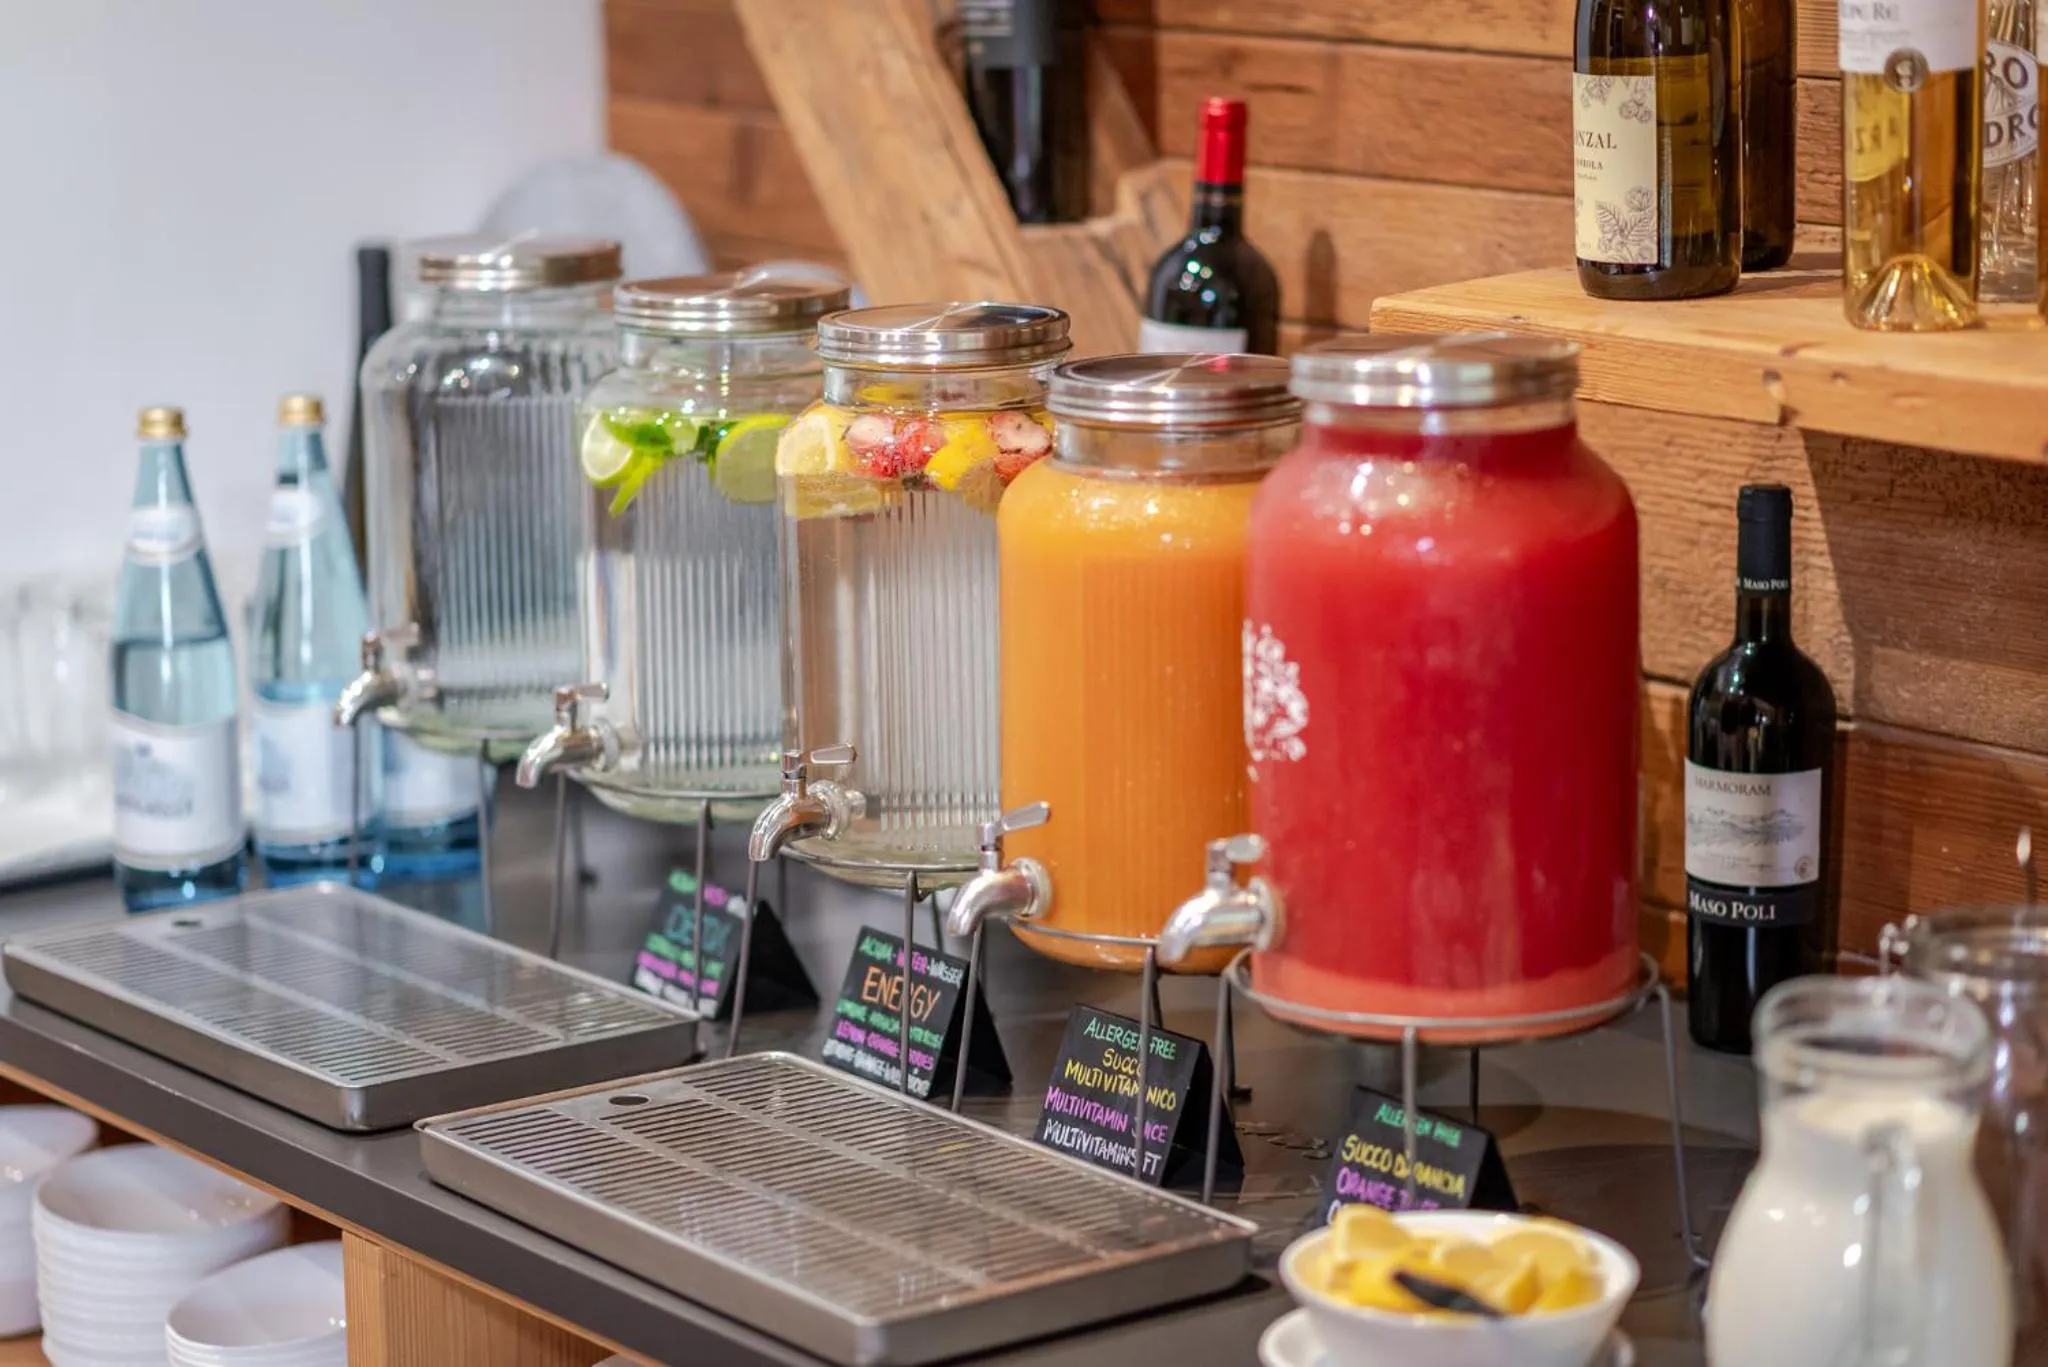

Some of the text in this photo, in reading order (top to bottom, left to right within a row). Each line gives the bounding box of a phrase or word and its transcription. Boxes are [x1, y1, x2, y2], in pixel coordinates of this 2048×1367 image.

[1689, 891, 1776, 921] MASO POLI
[861, 964, 941, 1023] ENEGY
[1044, 1086, 1129, 1132] MULTIVITAMIN
[1064, 1058, 1177, 1112] MULTIVITAMNICO
[1043, 1119, 1163, 1176] MULTIVITAMINSFT
[1341, 1134, 1392, 1172] SUCCO
